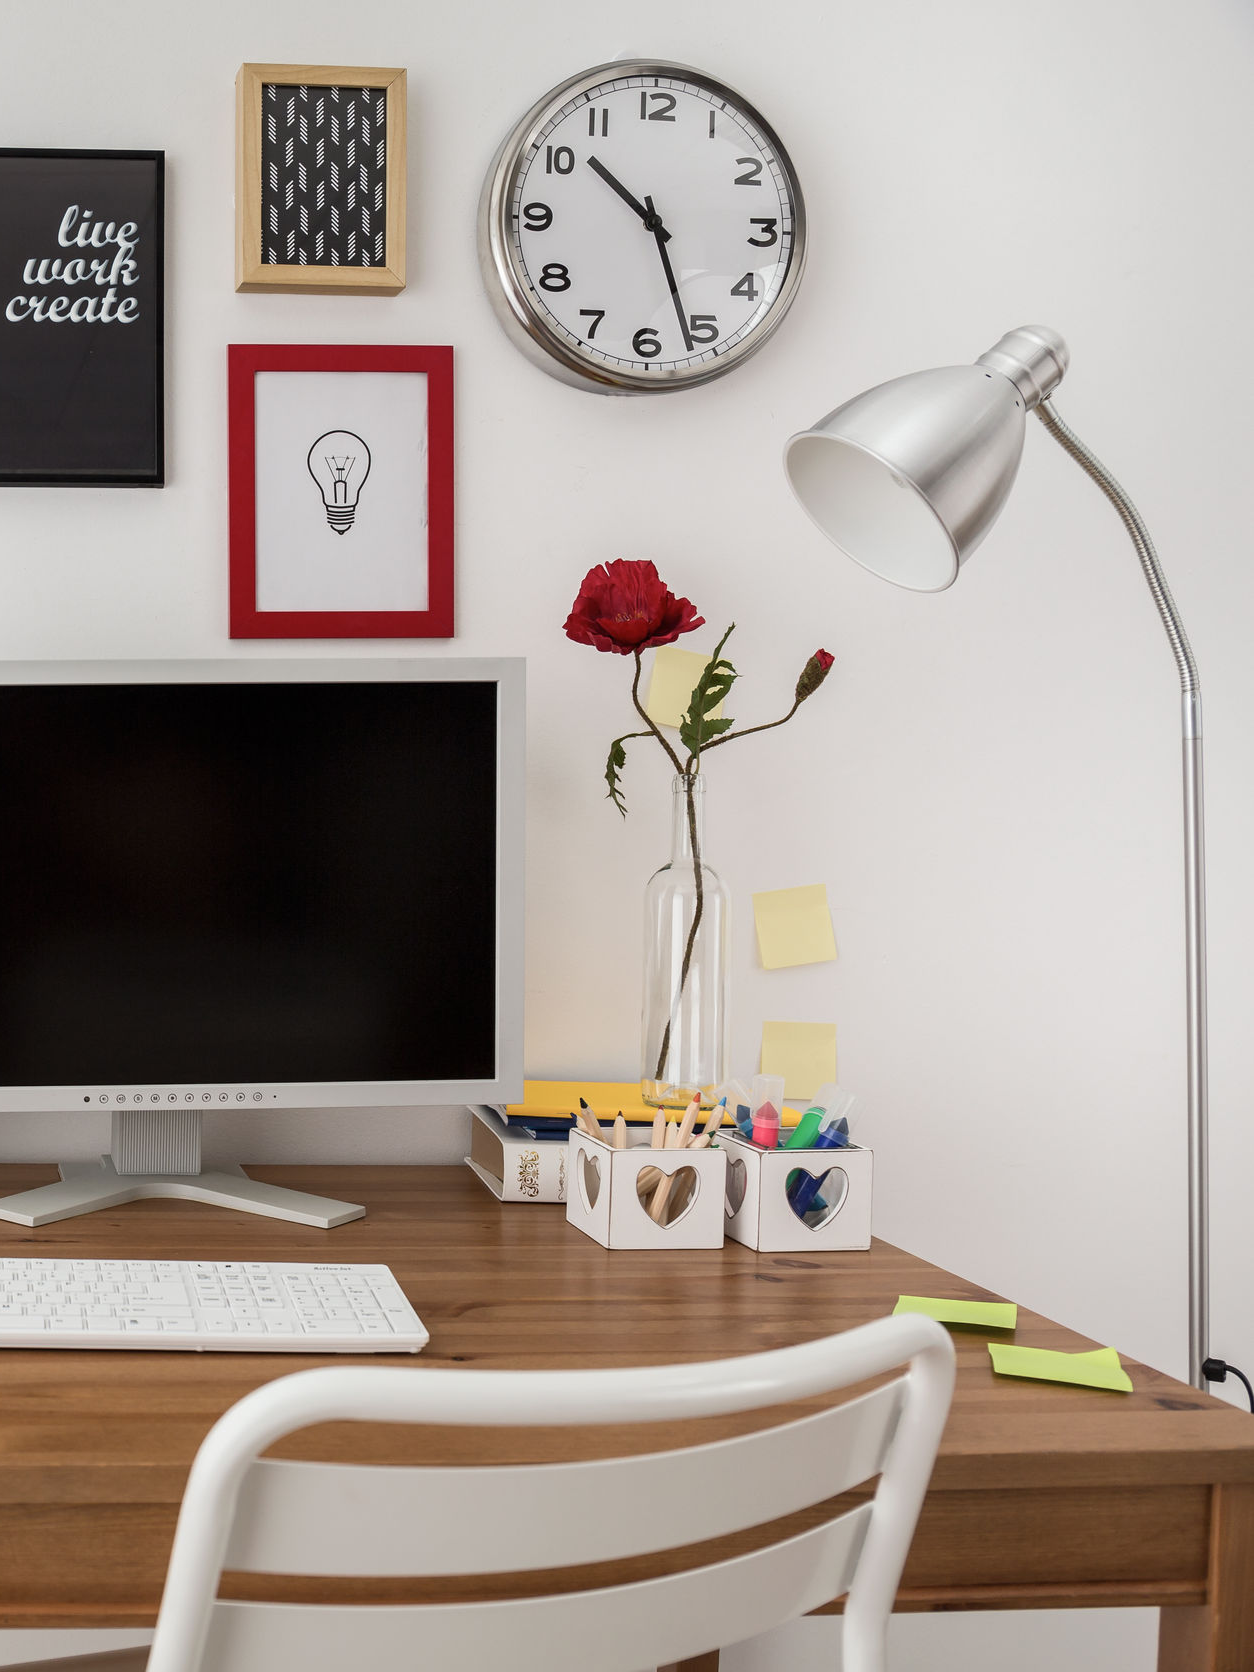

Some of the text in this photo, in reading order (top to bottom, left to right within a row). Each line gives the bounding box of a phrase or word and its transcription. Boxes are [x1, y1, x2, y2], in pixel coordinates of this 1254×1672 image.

[640, 91, 677, 122] 12
[588, 107, 609, 137] 11
[709, 110, 715, 139] 1
[546, 145, 575, 175] 10
[734, 157, 763, 186] 2
[57, 204, 140, 248] live
[523, 202, 554, 232] 9
[747, 217, 778, 248] 3
[22, 244, 140, 286] work
[539, 263, 572, 292] 8
[730, 272, 759, 301] 4
[5, 287, 140, 324] create
[579, 309, 606, 339] 7
[689, 314, 720, 344] 5
[632, 327, 662, 358] 6
